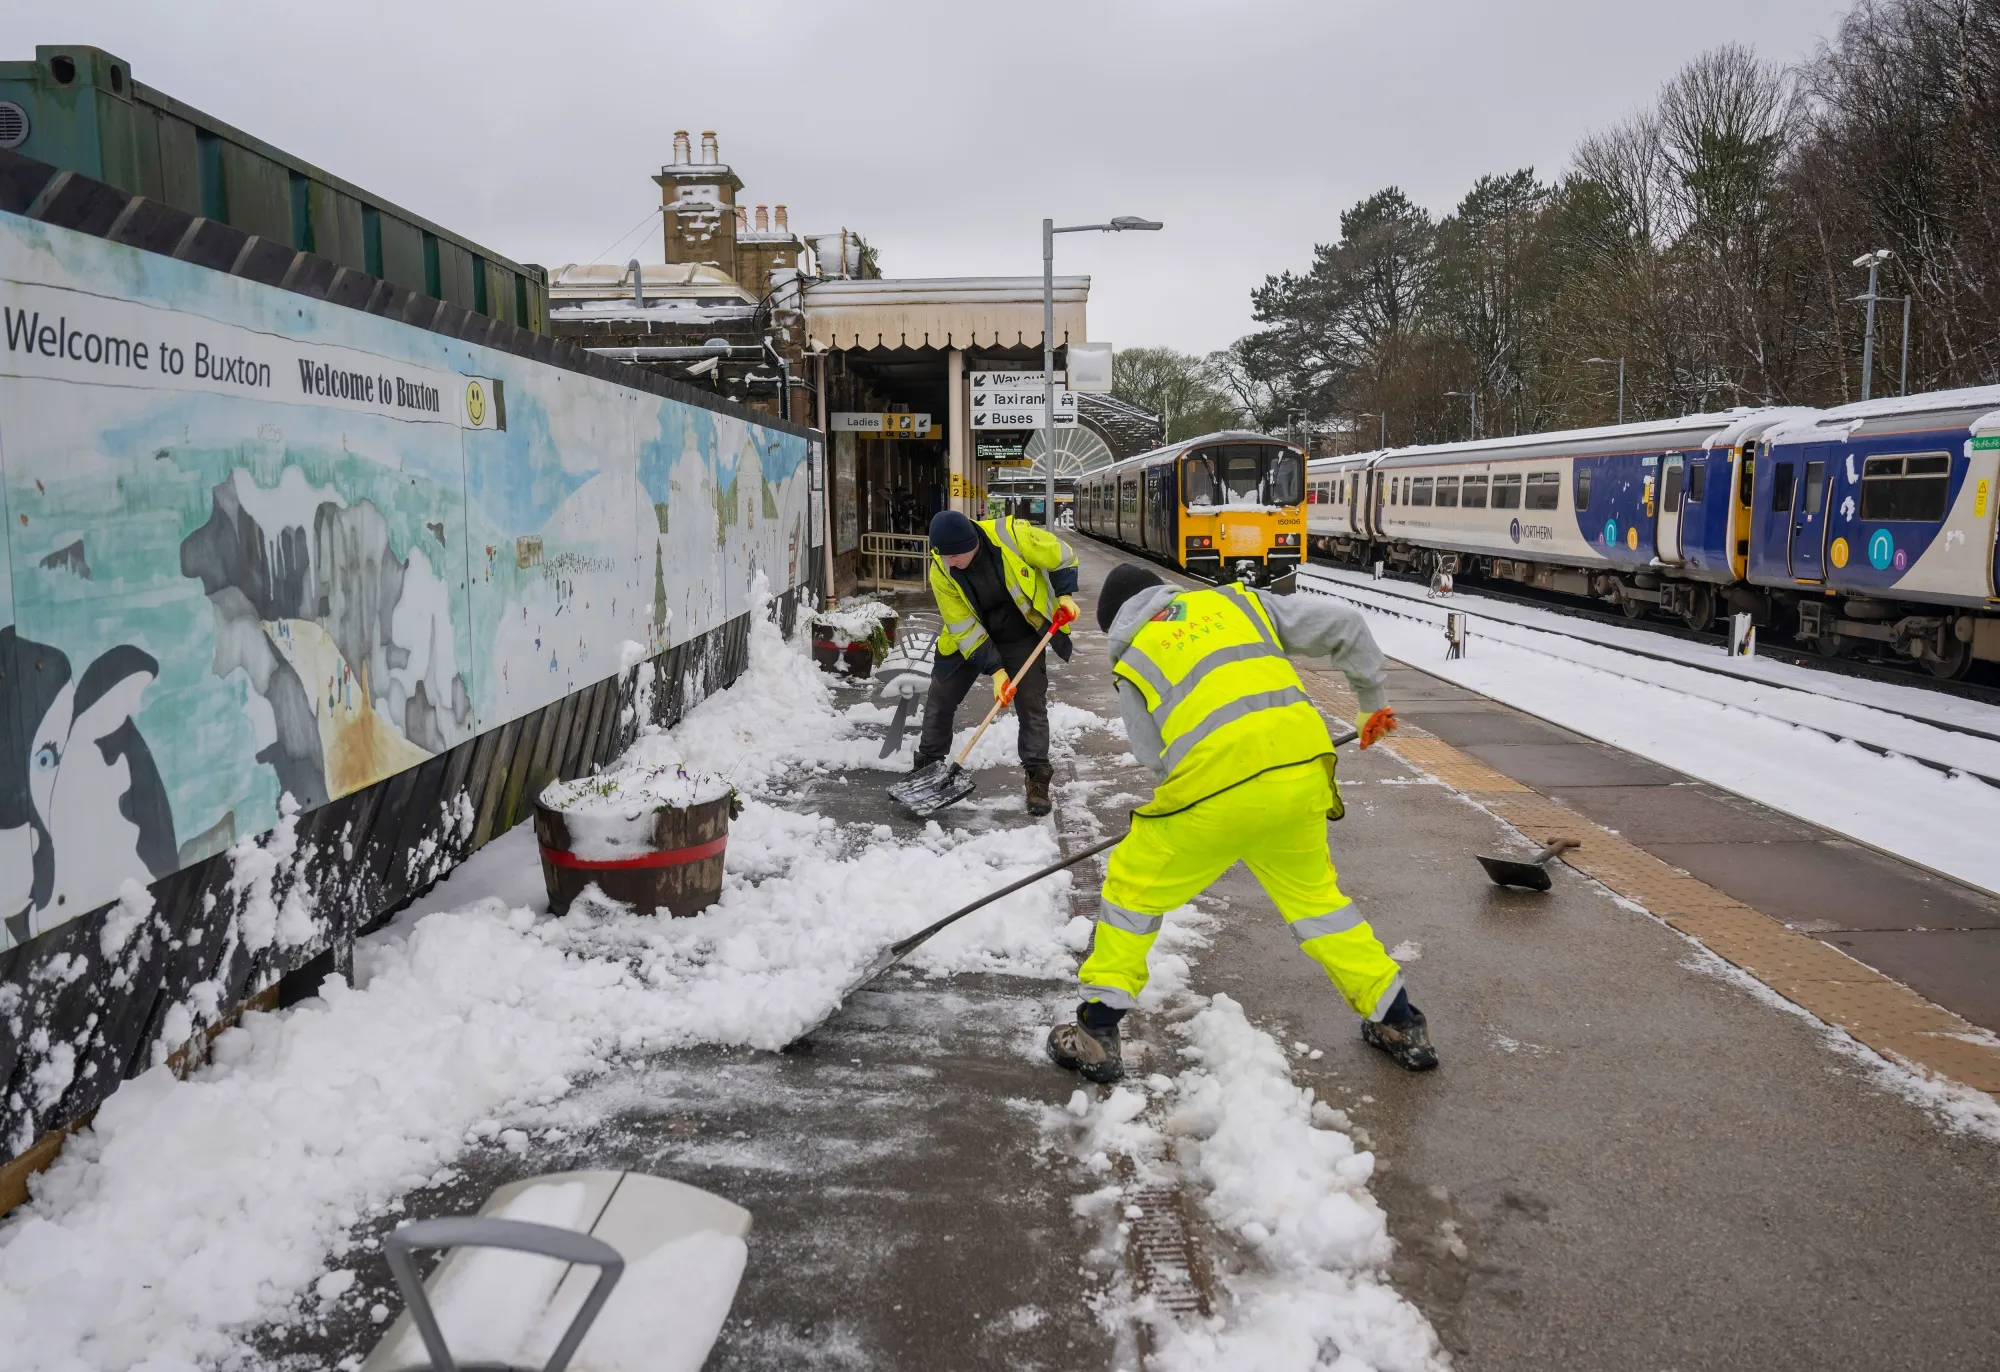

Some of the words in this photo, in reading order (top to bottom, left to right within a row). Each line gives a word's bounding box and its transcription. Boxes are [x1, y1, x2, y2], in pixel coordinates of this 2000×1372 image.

[3, 305, 149, 371] Welcome
[159, 341, 184, 376] to
[194, 341, 271, 388] Buxton
[297, 357, 374, 404] Welcome
[377, 373, 393, 405] to
[395, 376, 441, 413] Buxton
[992, 373, 1021, 388] Way
[993, 393, 1018, 405] Taxi
[1020, 393, 1046, 405] rank
[847, 417, 880, 427] Ladies
[992, 412, 1033, 424] Buses
[953, 488, 960, 497] 2
[1277, 518, 1301, 526] 150106
[1520, 524, 1553, 541] NORTHERN
[1160, 611, 1224, 650] SMART
[1176, 621, 1226, 652] PAVE
